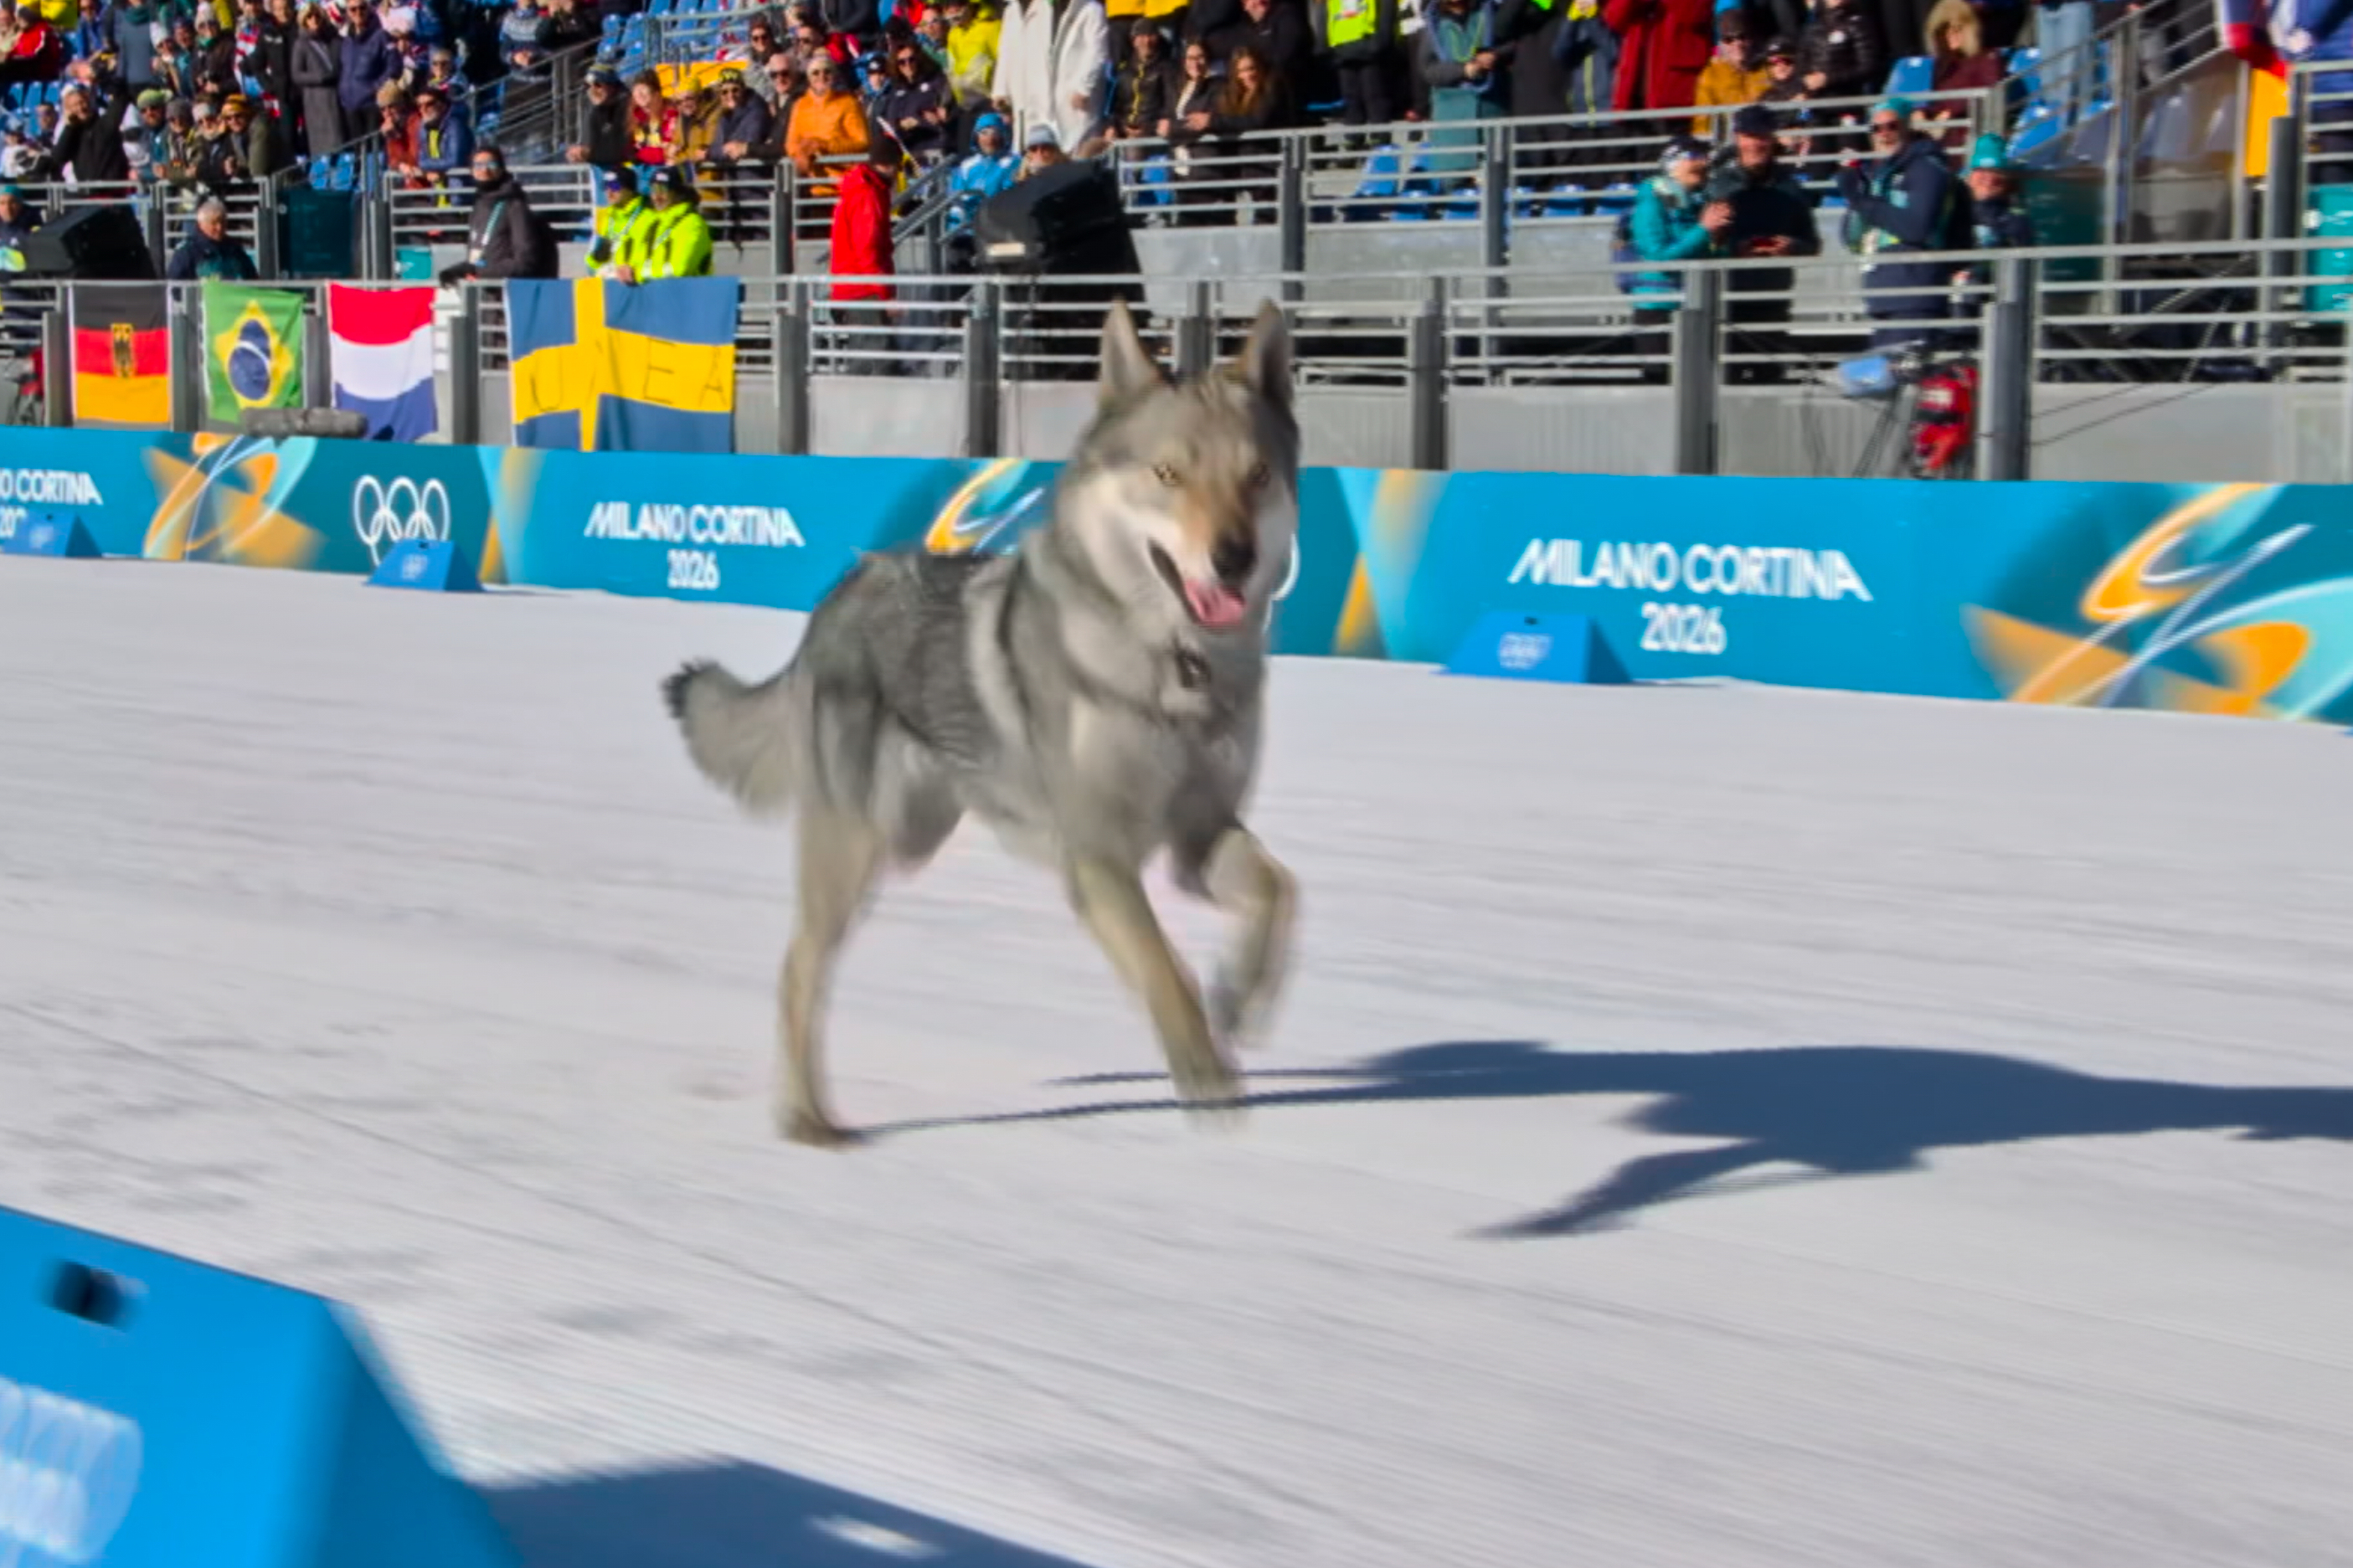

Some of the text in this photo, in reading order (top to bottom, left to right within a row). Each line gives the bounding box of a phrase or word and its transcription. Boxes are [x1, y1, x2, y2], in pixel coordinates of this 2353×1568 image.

[16, 469, 103, 505] CORTINA
[584, 501, 806, 548] MILANO CORTINA
[667, 549, 720, 590] 2026
[1508, 538, 1873, 602] MILANO CORTINA
[1640, 601, 1727, 654] 2026
